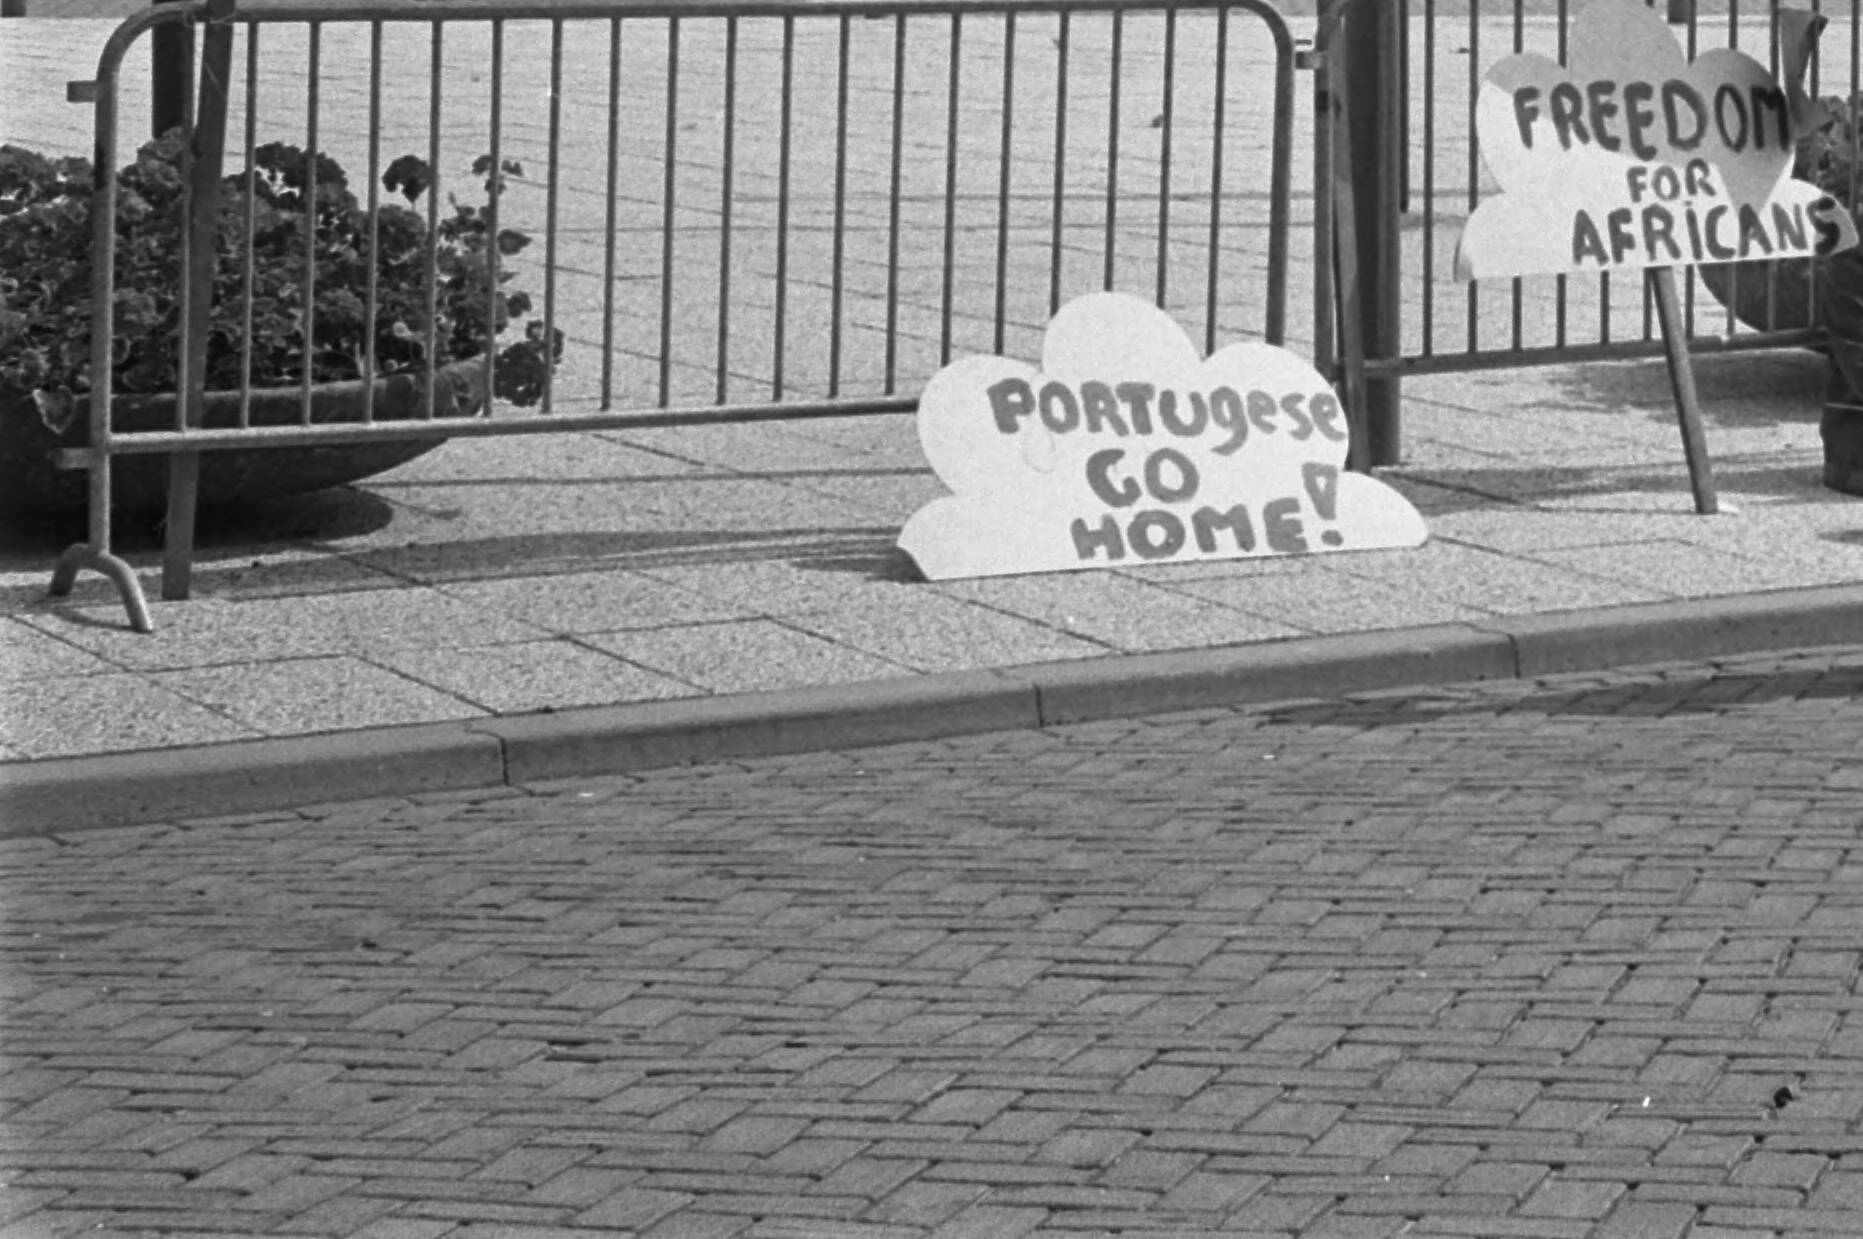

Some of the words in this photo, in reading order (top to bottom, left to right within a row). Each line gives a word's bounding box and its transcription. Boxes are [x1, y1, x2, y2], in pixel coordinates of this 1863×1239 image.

[1513, 78, 1790, 161] FREEDOM
[1626, 158, 1716, 203] FOR
[1070, 462, 1344, 560] HOME!
[1086, 447, 1199, 508] GO
